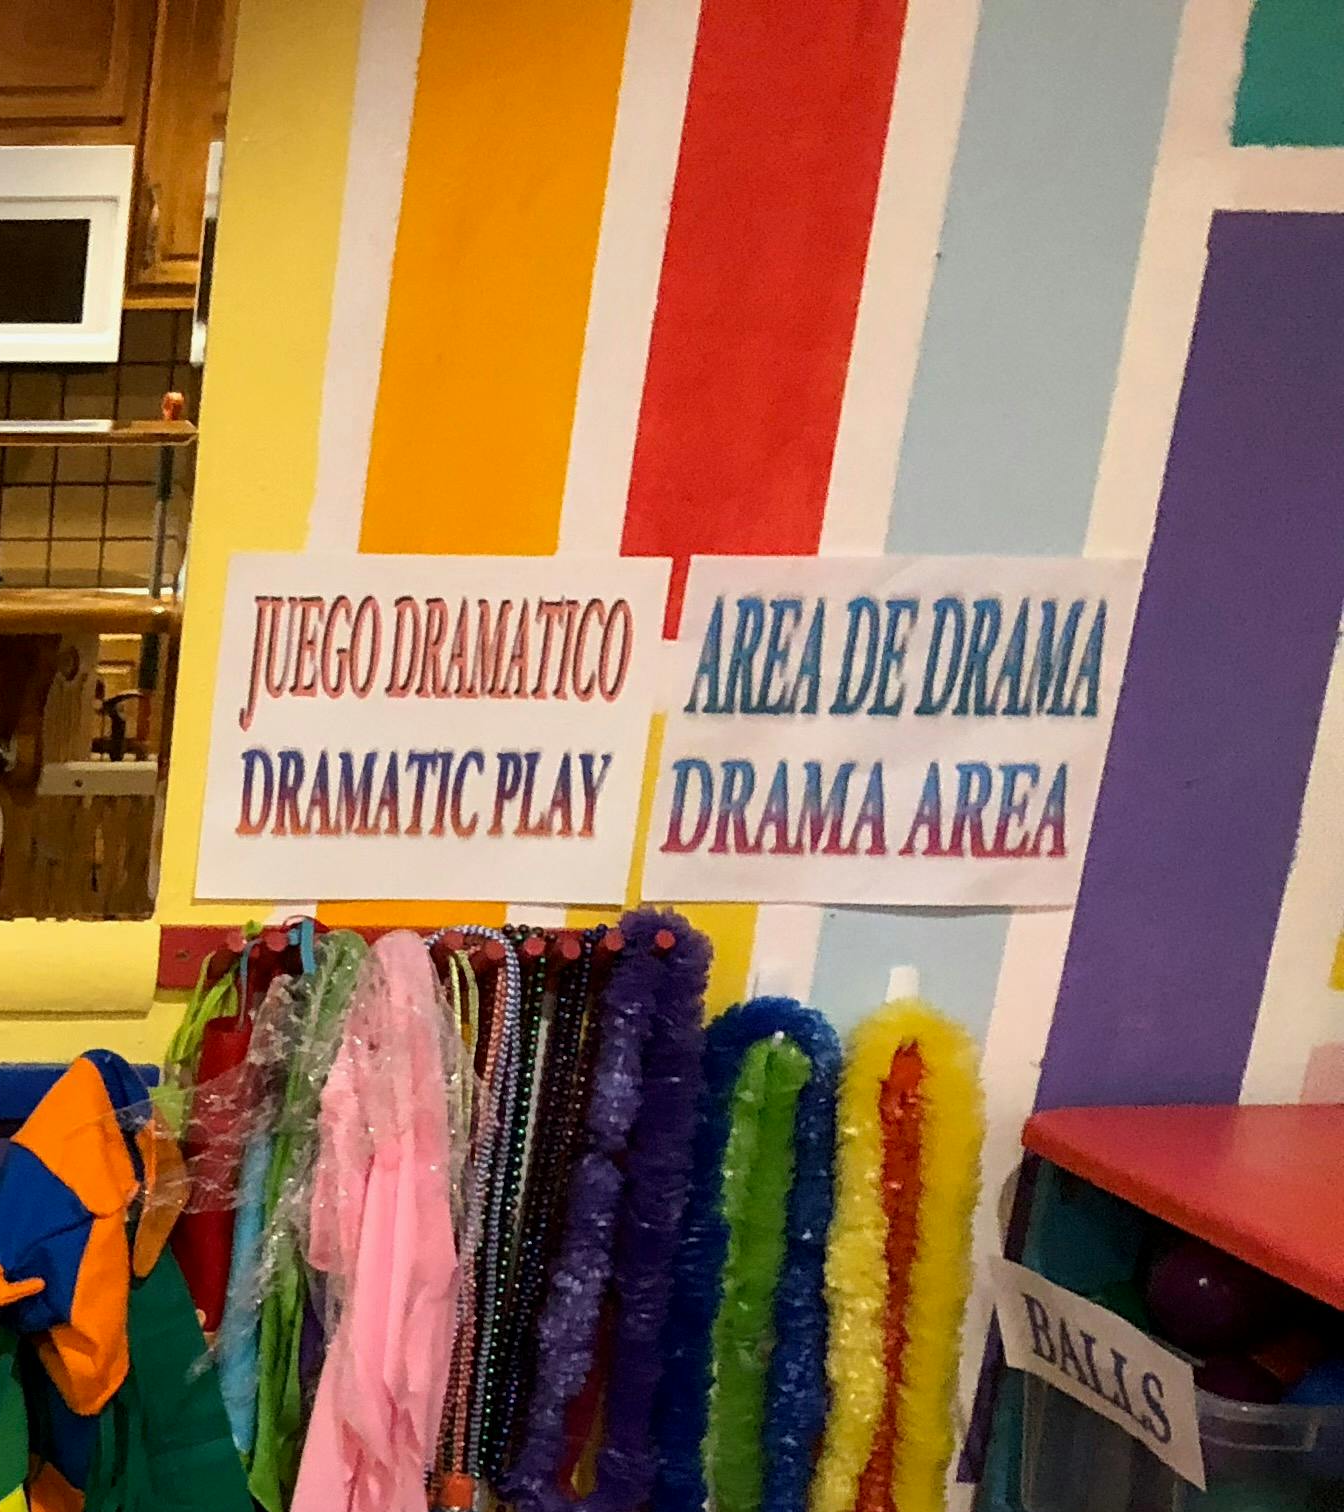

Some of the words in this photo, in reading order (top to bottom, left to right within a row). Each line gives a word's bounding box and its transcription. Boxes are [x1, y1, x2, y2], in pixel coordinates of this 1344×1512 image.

[239, 592, 378, 732] JUEGO
[384, 595, 635, 706] DRAMATICO
[682, 595, 828, 716] AREA
[828, 595, 913, 717] DE
[914, 594, 1111, 719] DRAMA
[236, 745, 483, 839] DRAMATIC
[490, 748, 613, 840] PLAY
[659, 756, 889, 858] DRAMA
[899, 761, 1070, 862] AREA
[1022, 1293, 1173, 1446] BALLS
